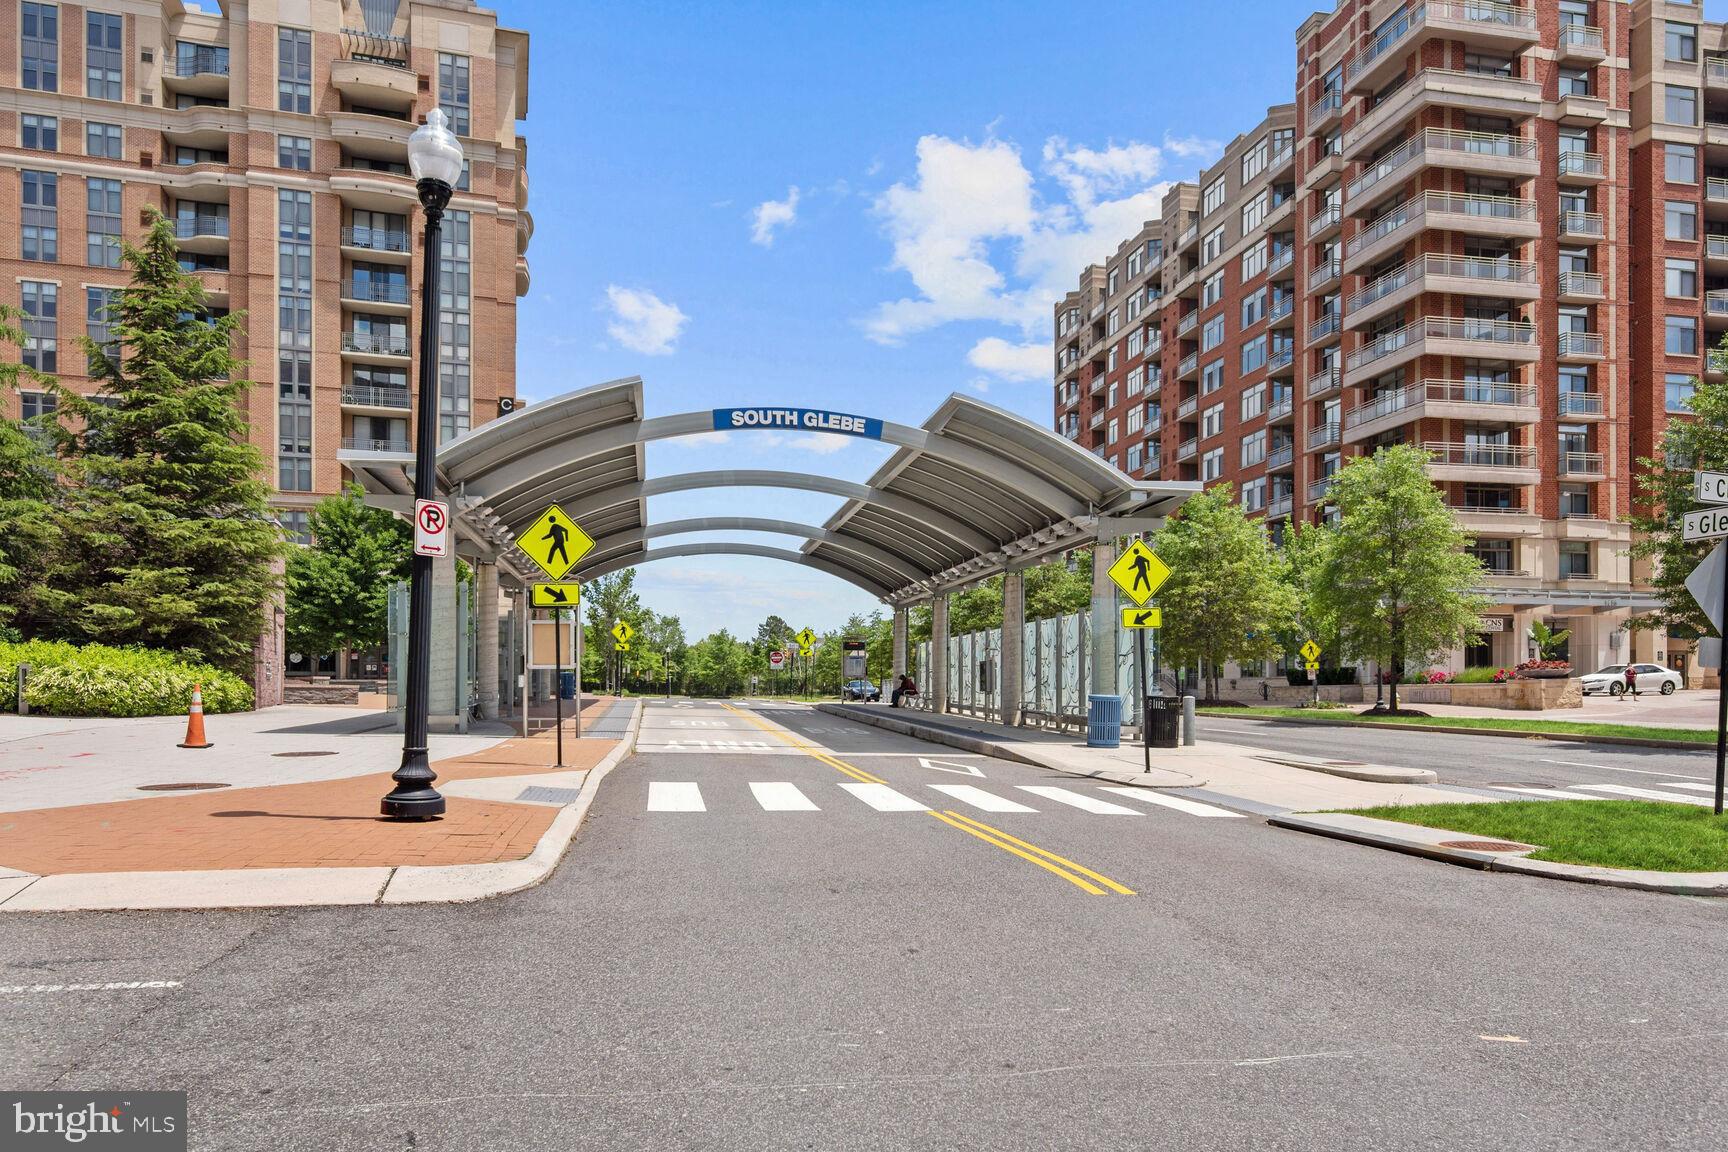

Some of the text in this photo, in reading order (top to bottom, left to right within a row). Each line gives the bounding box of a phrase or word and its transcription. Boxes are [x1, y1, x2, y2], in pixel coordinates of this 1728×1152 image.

[501, 398, 512, 410] C
[731, 410, 866, 433] SOUTH GLEBE
[1704, 481, 1710, 492] S
[427, 509, 441, 529] P
[1688, 513, 1728, 534] S Gle
[663, 740, 774, 751] ONLY
